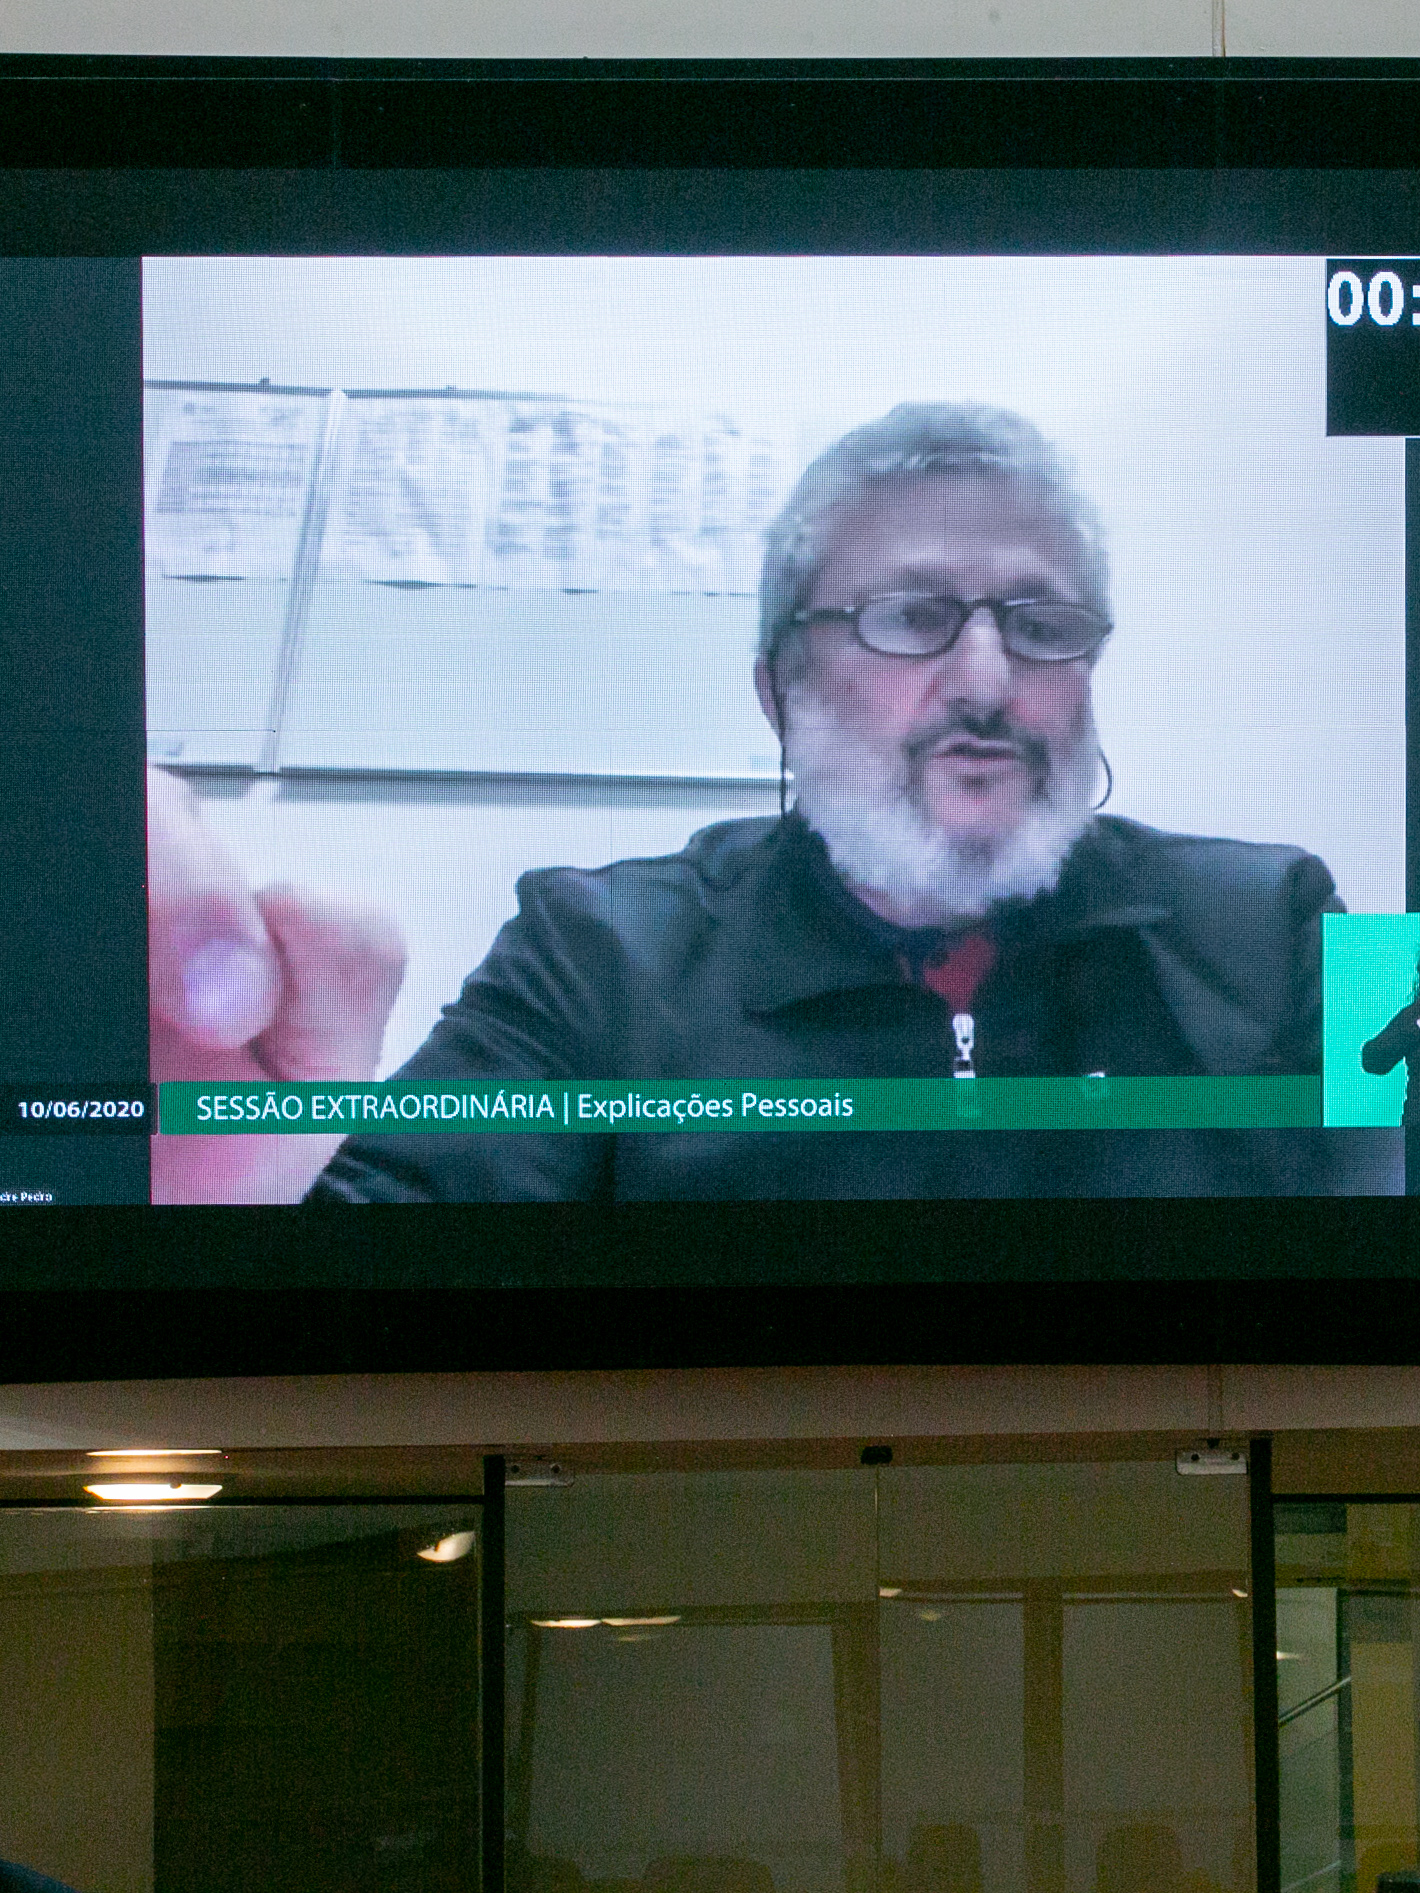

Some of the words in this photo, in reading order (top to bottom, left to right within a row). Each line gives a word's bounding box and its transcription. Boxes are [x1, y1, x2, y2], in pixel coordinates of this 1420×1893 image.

[18, 1100, 145, 1119] 10/06/2020
[196, 1091, 303, 1120] SESSÃO
[311, 1089, 555, 1120] EXTRAORDINÁRIA
[577, 1092, 734, 1124] Explicações
[741, 1092, 854, 1117] Pessoais
